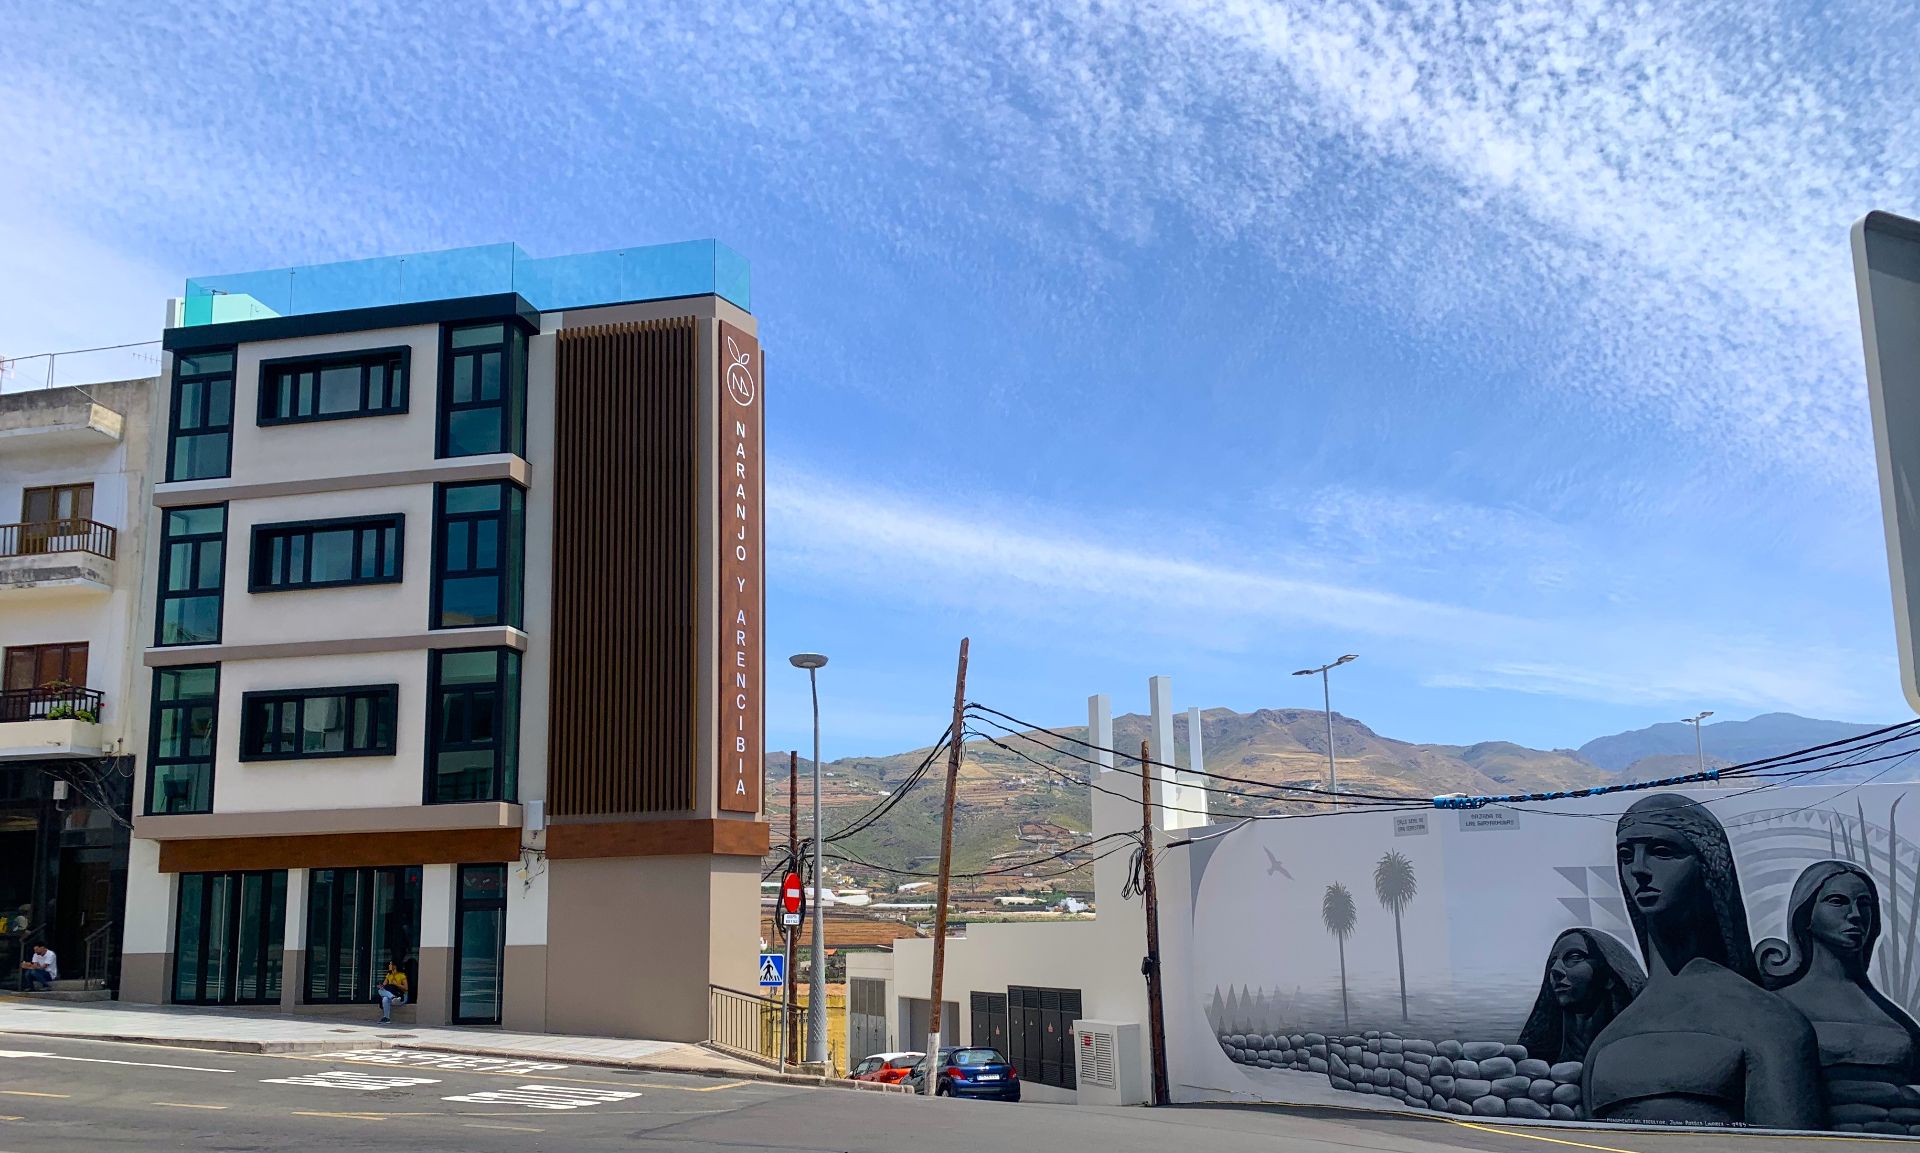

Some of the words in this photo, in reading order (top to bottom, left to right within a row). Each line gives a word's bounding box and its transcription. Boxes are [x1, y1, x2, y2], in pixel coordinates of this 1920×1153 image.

[735, 420, 746, 561] NARANJO
[736, 576, 746, 593] Y
[735, 609, 746, 796] ARENCIBIA
[347, 1049, 569, 1070] EXCEPTO
